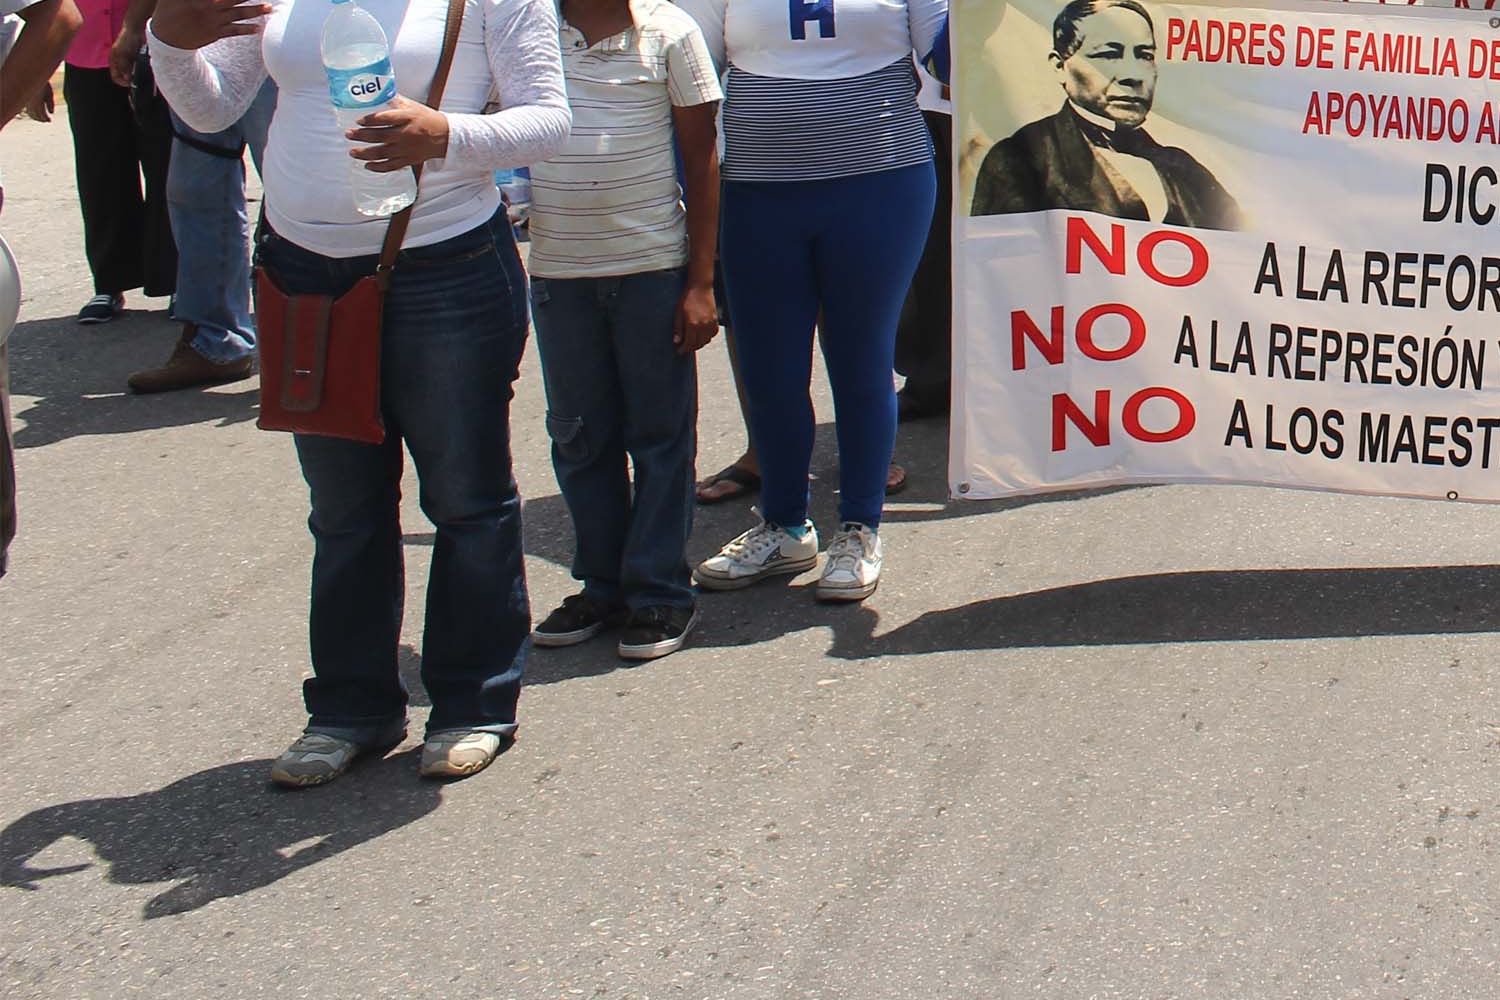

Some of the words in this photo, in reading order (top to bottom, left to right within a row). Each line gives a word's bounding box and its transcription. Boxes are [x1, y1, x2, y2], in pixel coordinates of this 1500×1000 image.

[1166, 17, 1286, 67] PADRES
[1295, 25, 1336, 70] DE
[1343, 29, 1460, 78] FAMILIA
[350, 76, 382, 96] ciel
[1302, 90, 1470, 144] APOYANDO
[1065, 216, 1210, 288] NO
[1253, 241, 1284, 298] A
[1295, 245, 1349, 304] LA
[1010, 303, 1147, 372] NO
[1173, 314, 1199, 369] A
[1209, 319, 1257, 377] LA
[1267, 324, 1486, 392] REPRESIÓN
[1051, 386, 1197, 453] NO
[1223, 398, 1254, 450] A
[1264, 403, 1346, 461] LOS
